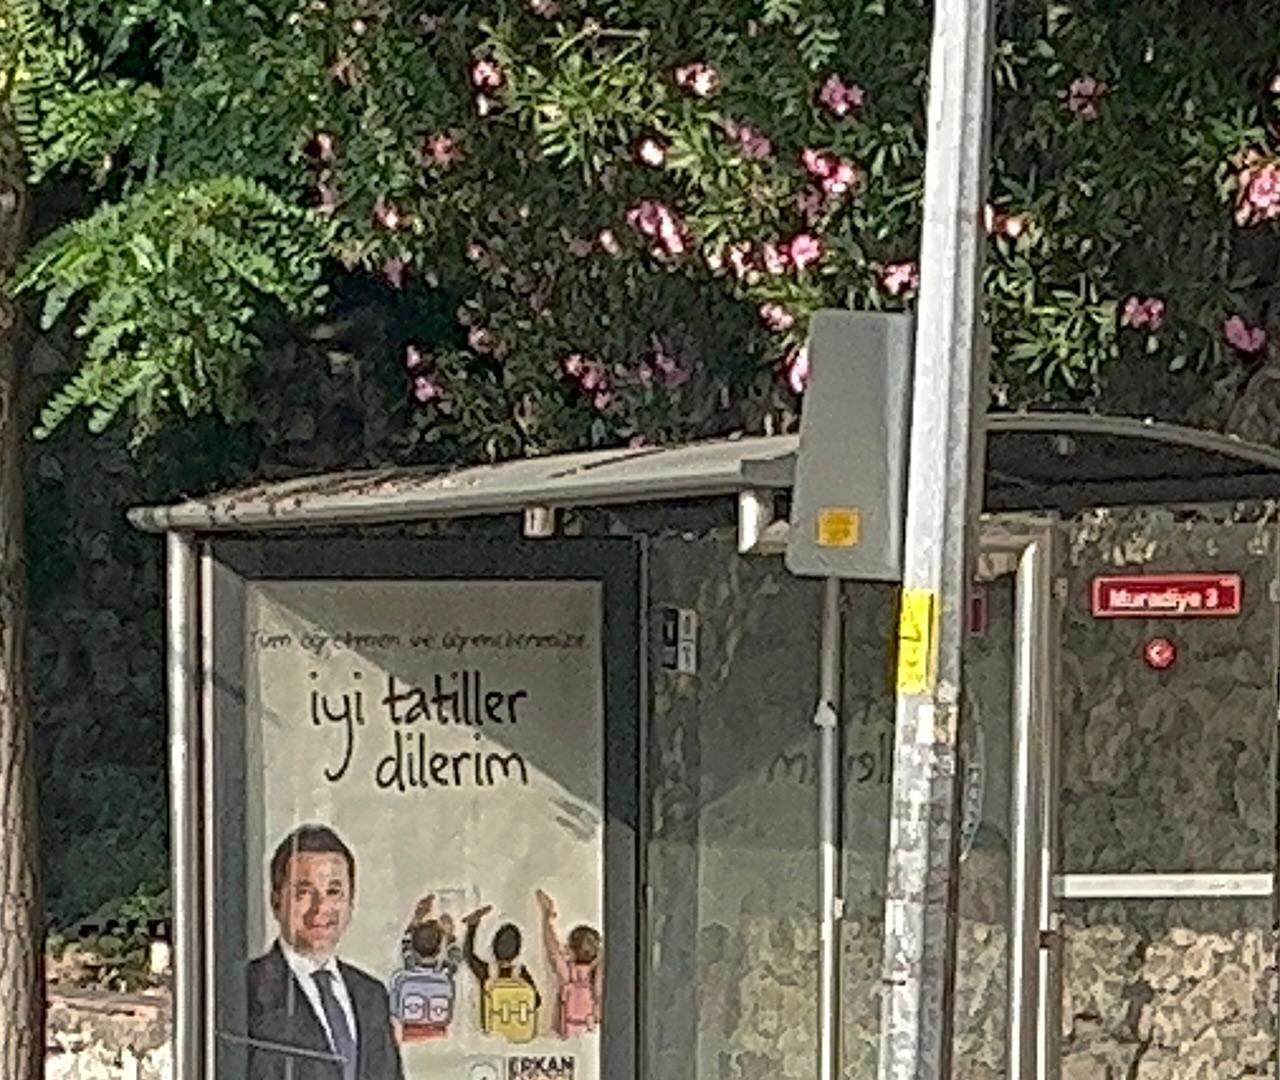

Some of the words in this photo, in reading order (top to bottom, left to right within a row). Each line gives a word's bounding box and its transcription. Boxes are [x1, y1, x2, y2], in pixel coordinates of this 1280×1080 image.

[1109, 587, 1202, 613] Muradiye
[1204, 587, 1219, 608] 3
[308, 670, 366, 783] iyi
[380, 669, 529, 726] tatiller
[375, 729, 529, 792] dilerim
[509, 1056, 575, 1074] ERKAN
